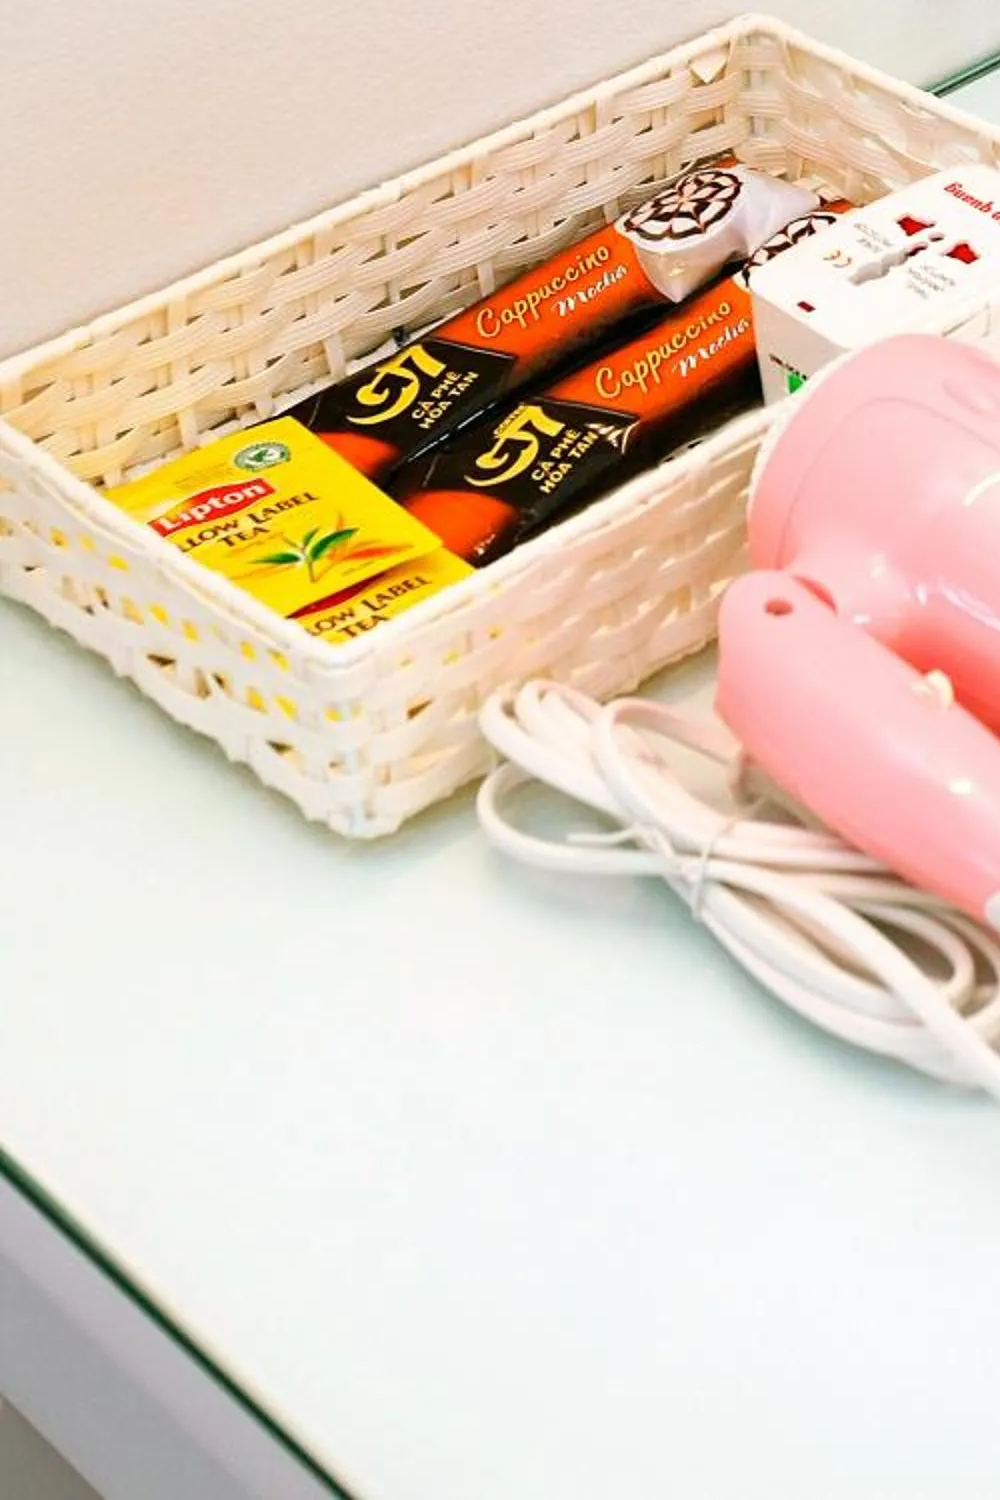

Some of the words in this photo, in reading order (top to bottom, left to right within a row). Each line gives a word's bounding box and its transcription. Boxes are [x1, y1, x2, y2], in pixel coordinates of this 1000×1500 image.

[476, 245, 609, 338] Cappuccino
[595, 302, 731, 398] Cappuccino
[447, 371, 479, 397] TAN
[567, 431, 599, 459] TAN
[158, 483, 268, 530] Lipton
[248, 492, 320, 524] LABEL
[217, 526, 271, 547] TEA
[362, 576, 432, 611] LABEL
[337, 615, 391, 637] TEA
